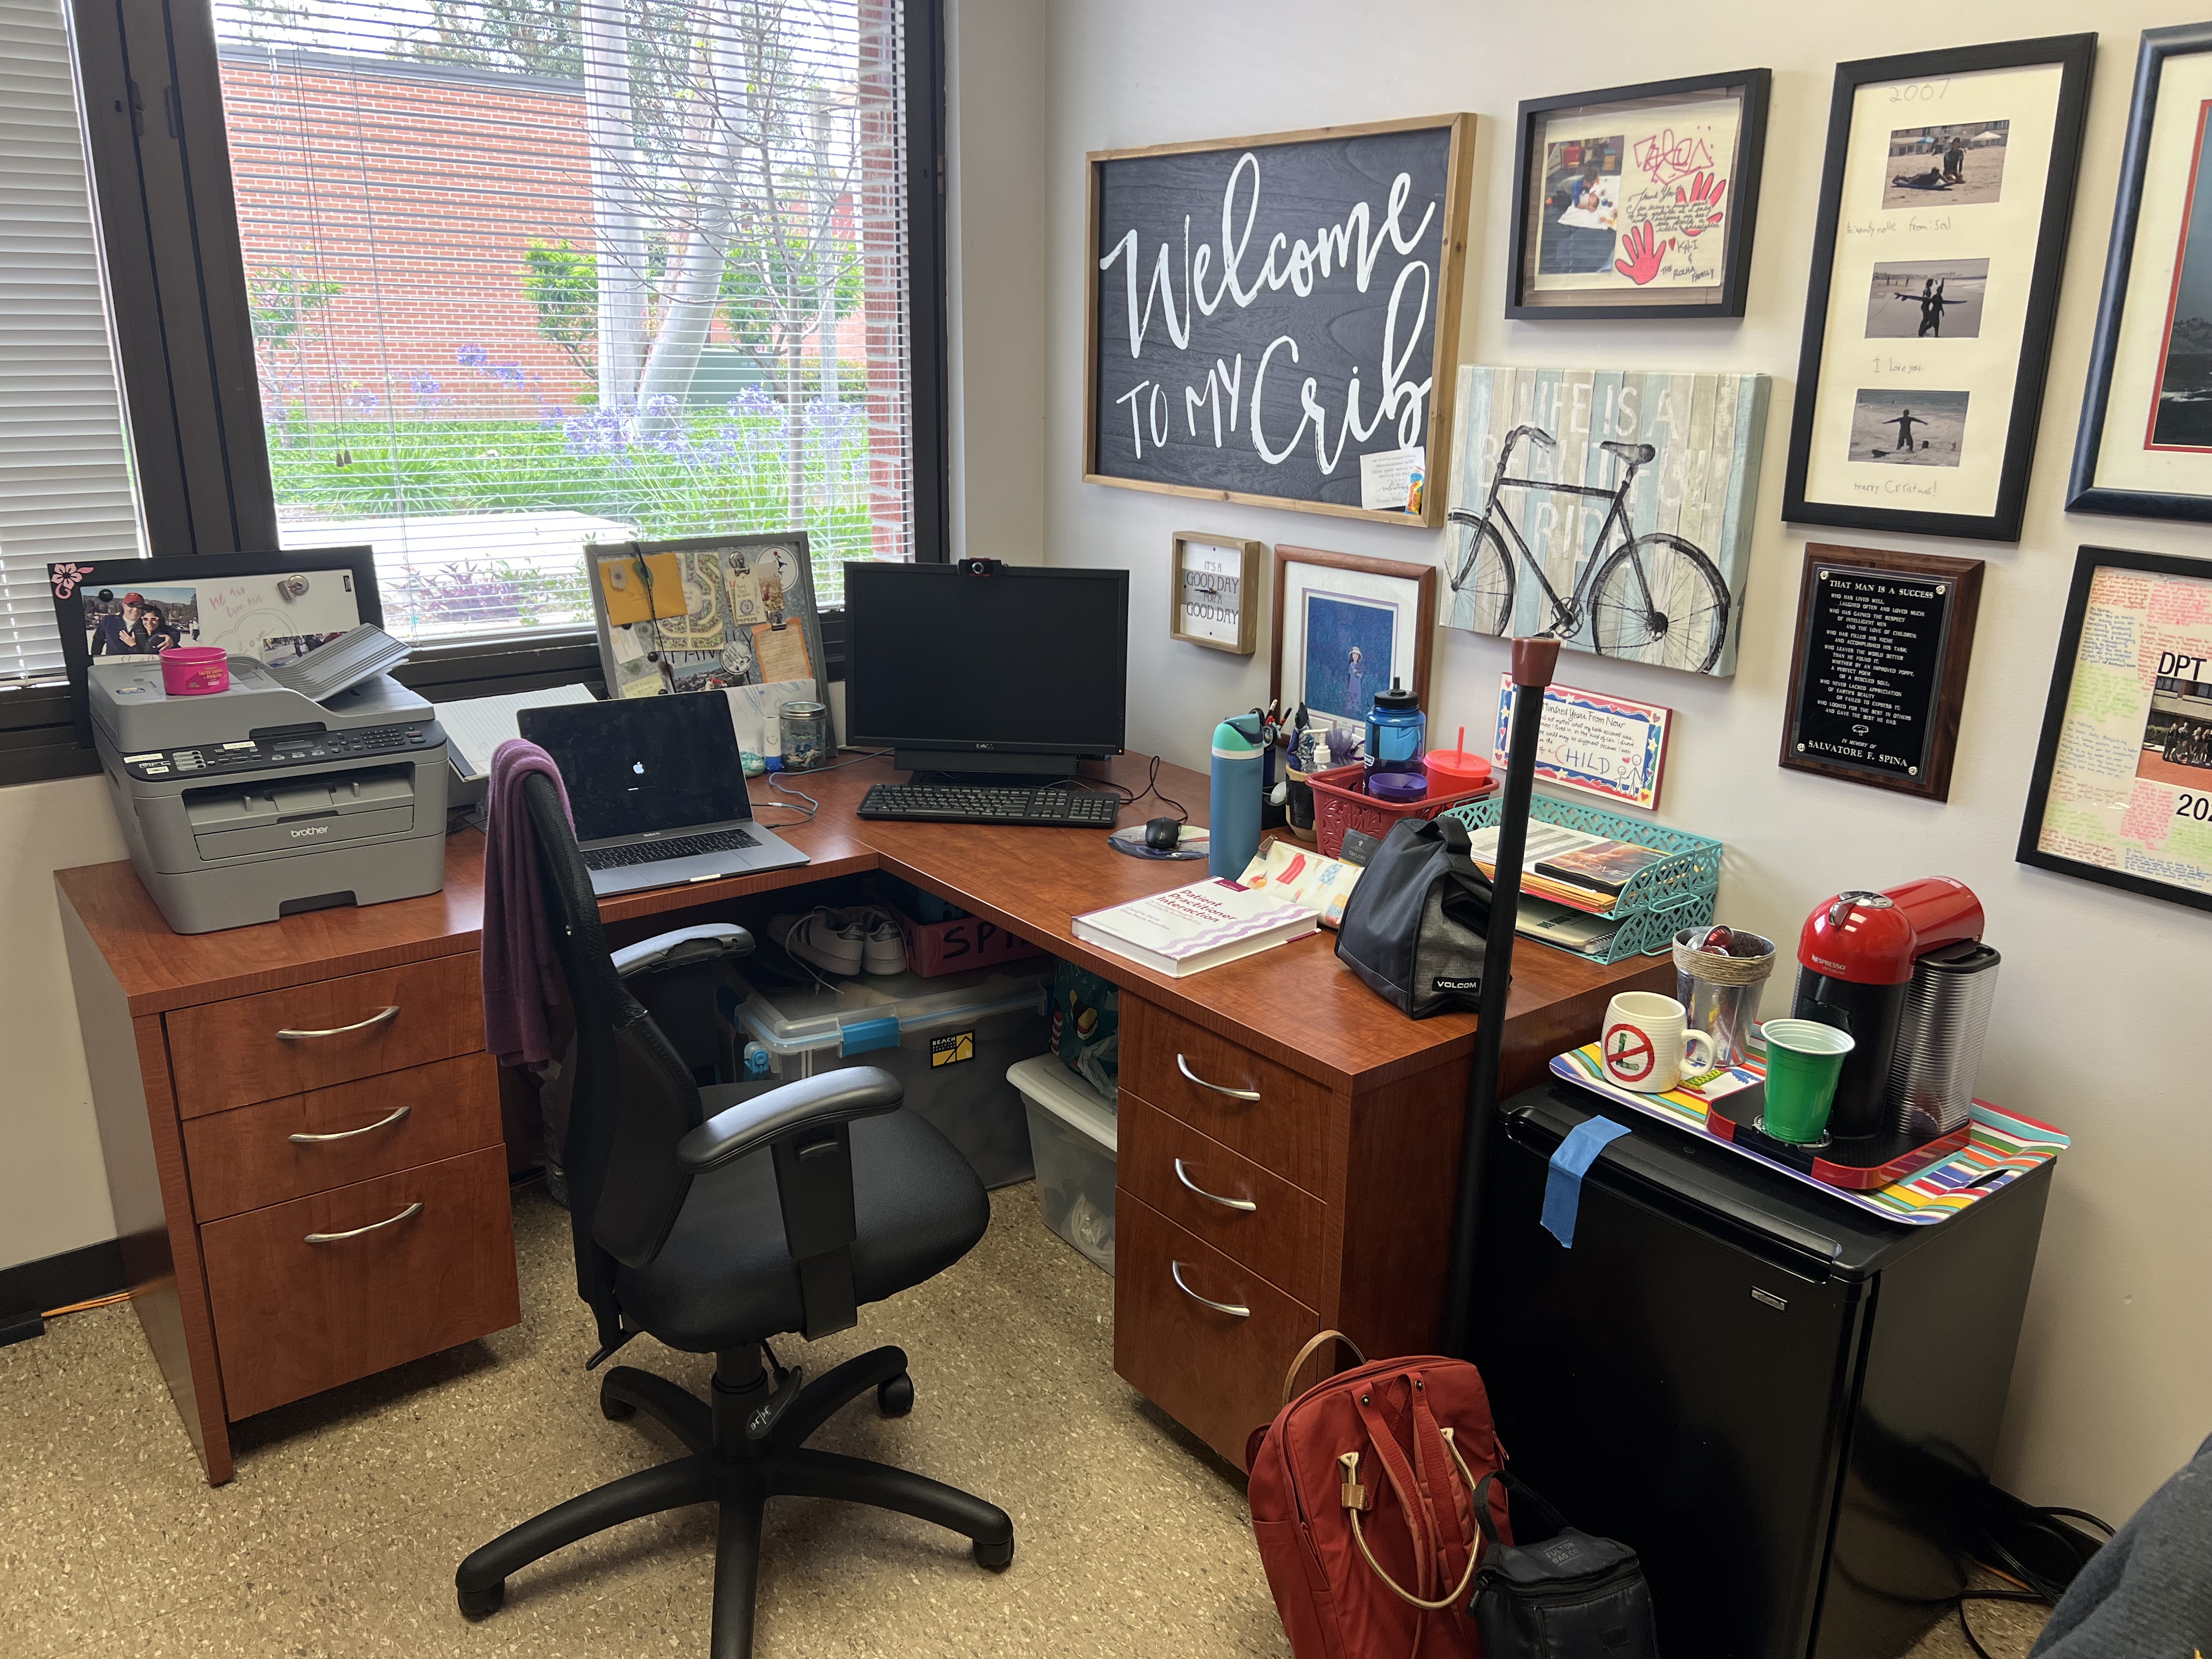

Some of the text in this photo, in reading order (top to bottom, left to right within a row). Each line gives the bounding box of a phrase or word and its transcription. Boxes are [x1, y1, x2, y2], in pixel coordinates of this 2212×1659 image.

[1889, 78, 1950, 102] 2007
[1099, 152, 1435, 358] Welcome
[1677, 239, 1698, 255] KALI
[1661, 265, 1672, 275] THE
[1116, 260, 1432, 476] TO MY Crib
[1889, 358, 1906, 373] Love
[1520, 382, 1679, 439] LIFE IS A
[1478, 433, 1712, 510] BEAUTIFUL
[1536, 502, 1632, 569] RIDE
[1205, 561, 1222, 573] IT'S A
[1187, 572, 1239, 593] GOOD DAY
[1854, 583, 1874, 591] MAN
[1899, 588, 1933, 599] SUCCESS
[1204, 592, 1222, 605] FOR A
[1187, 602, 1239, 624] GOOD DAY
[1847, 640, 1881, 648] ACCOMPLISHED
[2158, 651, 2208, 681] DPT
[1869, 687, 1901, 697] APPRECIATION
[1542, 702, 1626, 729] Hundred Years From Now
[1559, 735, 1569, 743] may
[1577, 738, 1599, 747] different
[1600, 743, 1617, 752] because
[1555, 744, 1610, 775] CHILD
[1808, 740, 1907, 767] SALVATORE F. SPINA
[291, 826, 329, 838] brother
[1348, 850, 1366, 861] TAYLORS
[1167, 893, 1238, 920] Practitioner
[1180, 889, 1223, 907] Patient
[1156, 896, 1220, 922] Interaction
[1812, 953, 1846, 970] NESPRESSO
[933, 1036, 956, 1046] BEACH
[1545, 1542, 1575, 1559] FULTON
[1551, 1552, 1568, 1564] BAG
